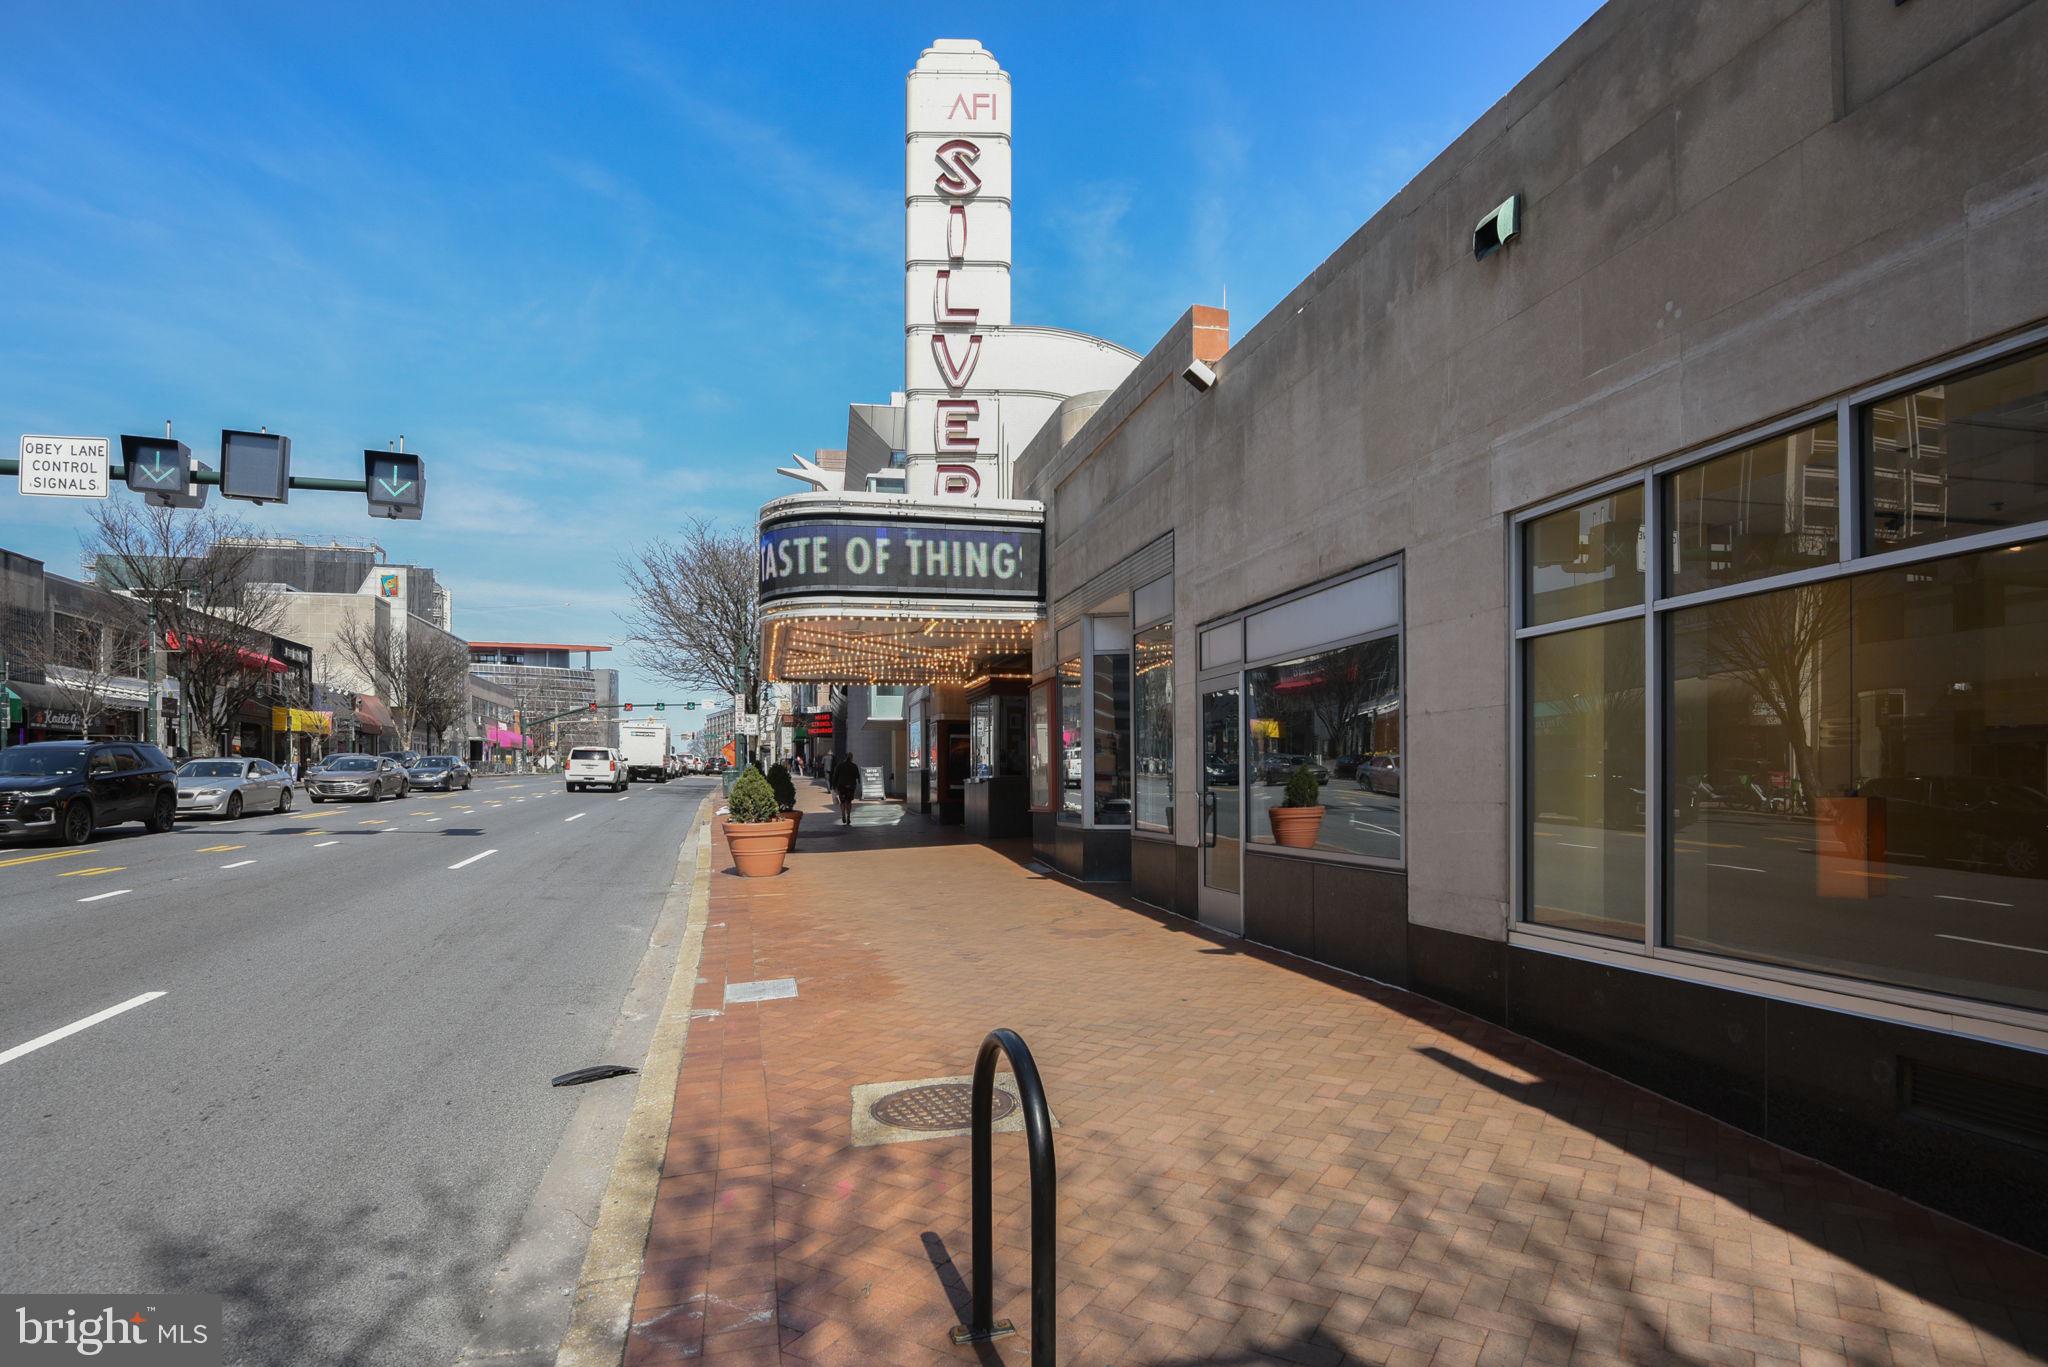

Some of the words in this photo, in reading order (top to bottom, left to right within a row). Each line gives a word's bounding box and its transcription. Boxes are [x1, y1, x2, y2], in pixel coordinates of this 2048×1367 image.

[947, 92, 997, 120] AFI
[25, 443, 63, 455] OBEY
[70, 445, 105, 457] LANE
[32, 460, 98, 474] CONTROL
[33, 476, 97, 491] SIGNALS
[845, 536, 891, 575] OF
[905, 538, 1023, 580] THING
